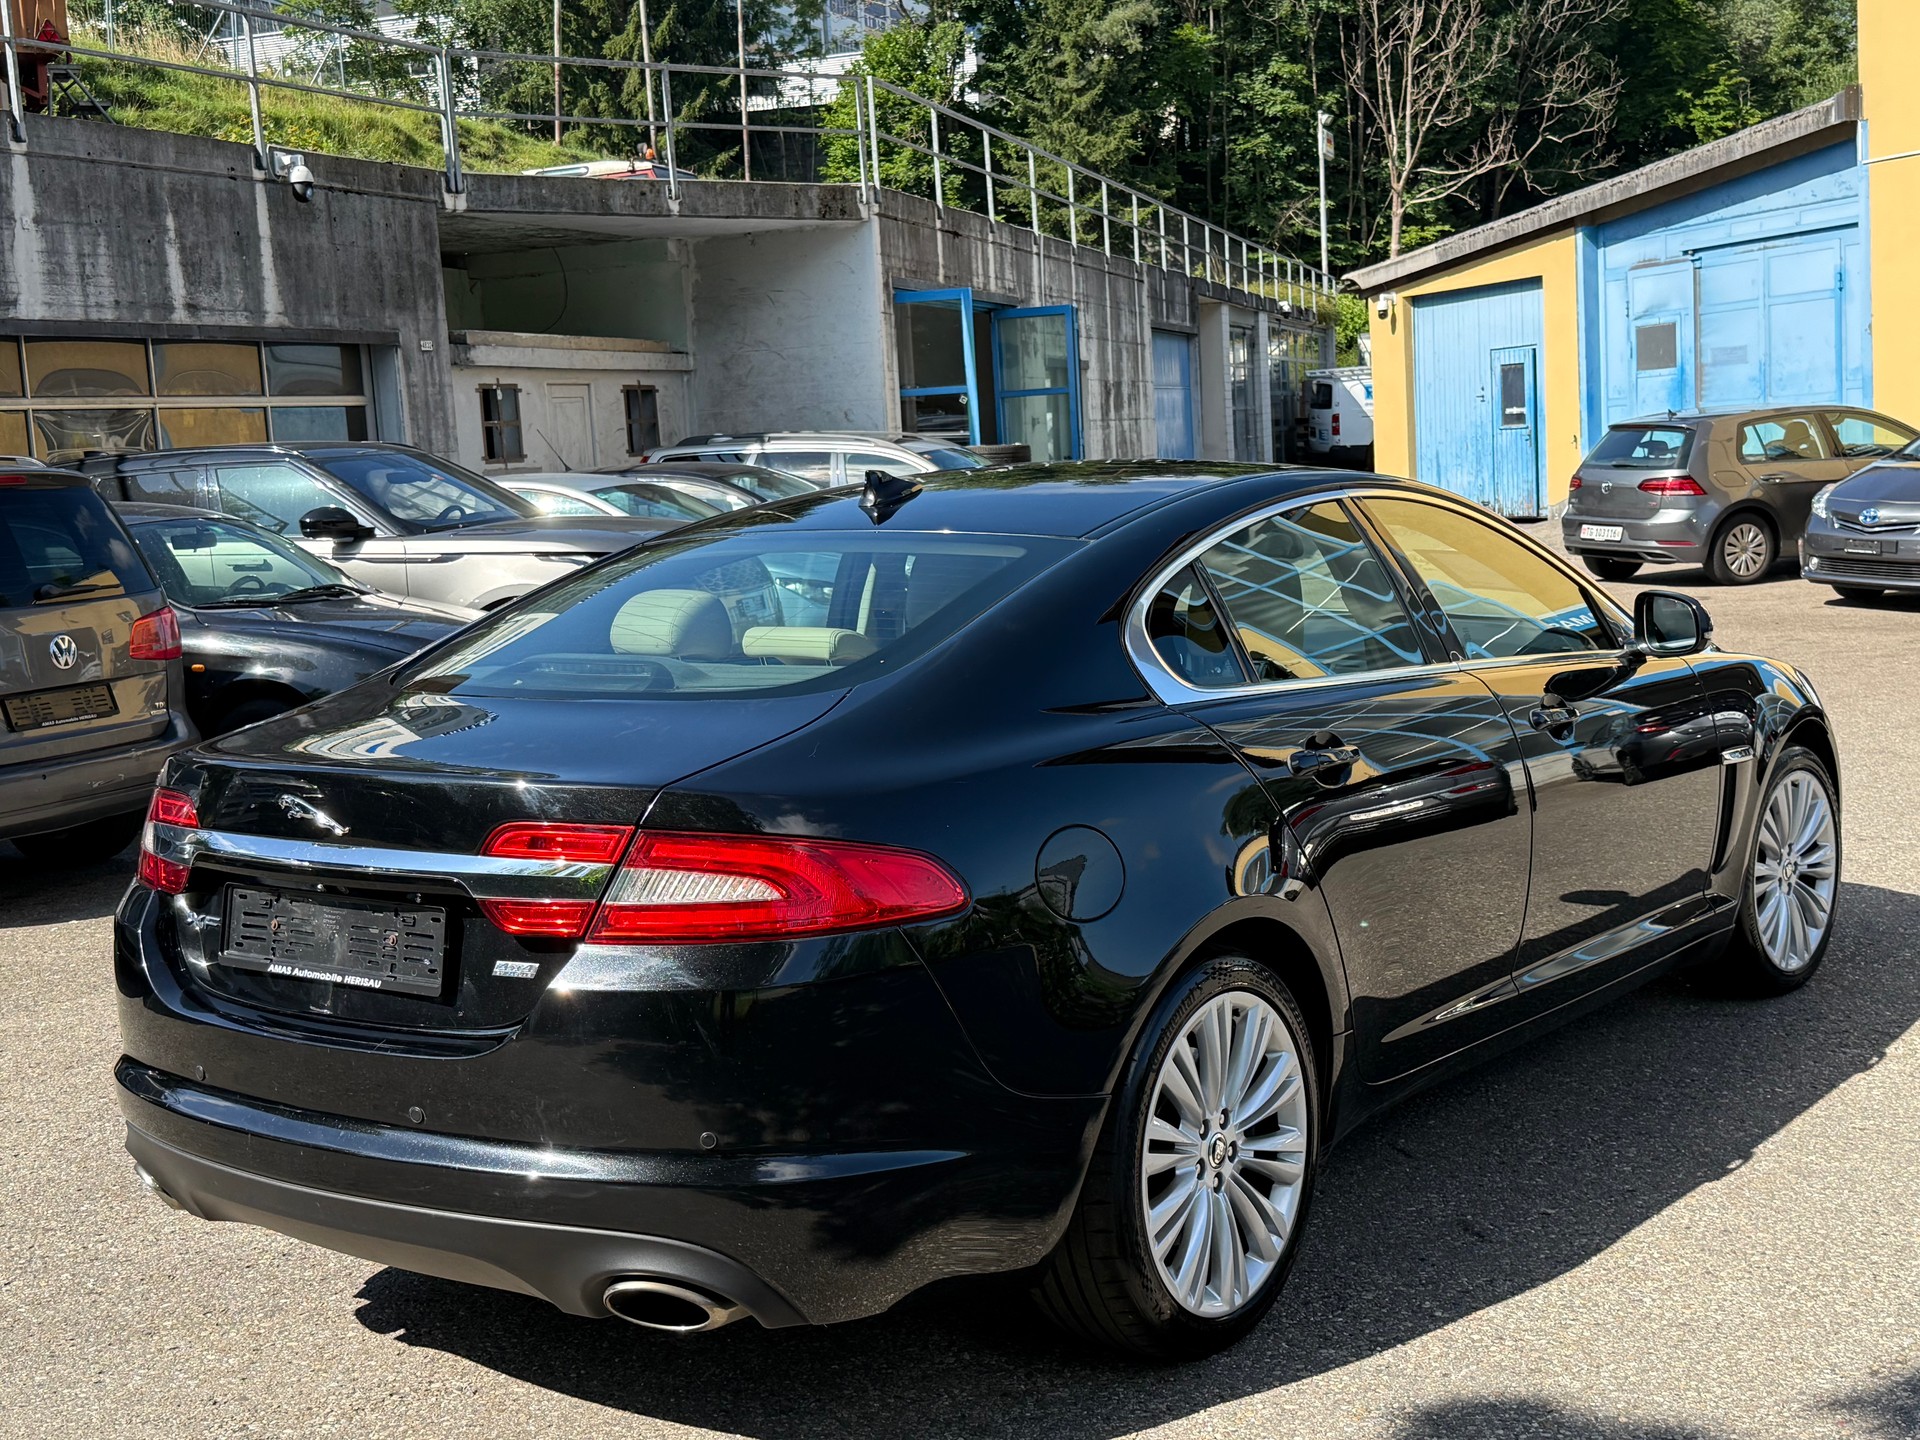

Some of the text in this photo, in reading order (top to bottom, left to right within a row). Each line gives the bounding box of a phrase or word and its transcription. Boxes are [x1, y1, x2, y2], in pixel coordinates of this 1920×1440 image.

[1586, 527, 1617, 539] TG 103116
[267, 964, 382, 988] AMAS Automobile HERISAU
